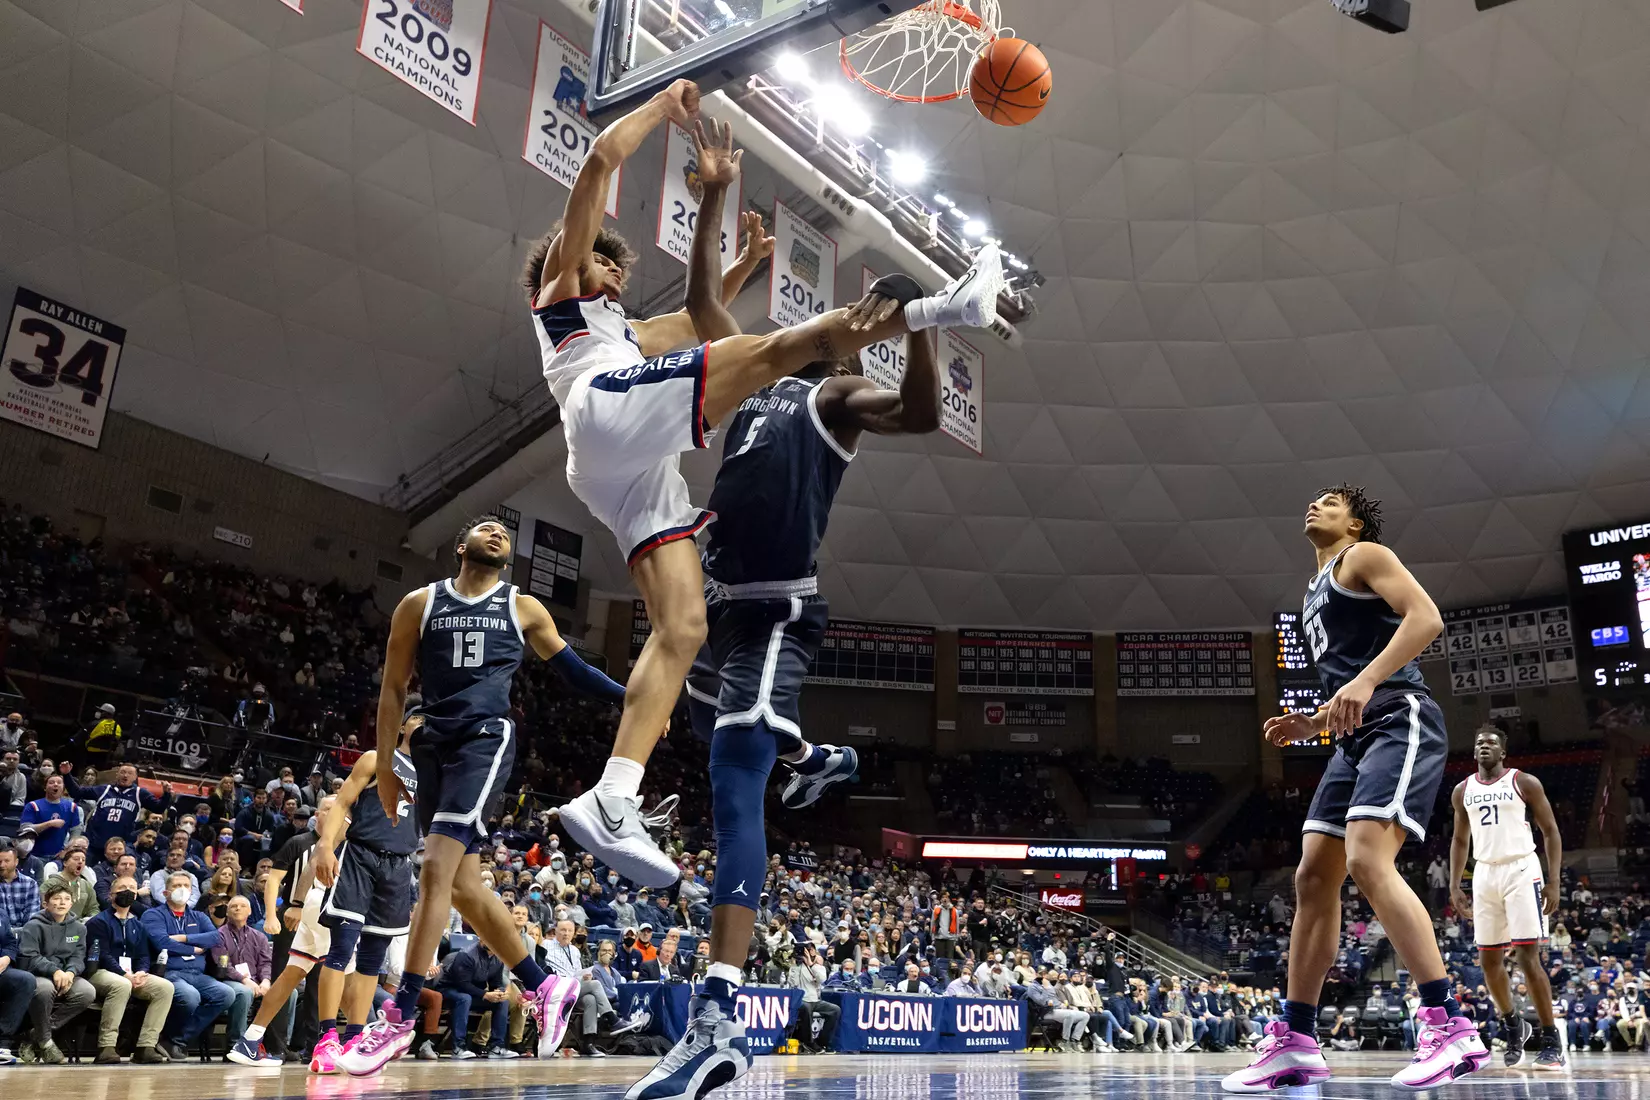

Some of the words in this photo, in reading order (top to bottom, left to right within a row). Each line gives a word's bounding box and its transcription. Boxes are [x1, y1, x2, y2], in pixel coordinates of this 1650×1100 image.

[375, 0, 472, 77] 2009
[549, 31, 580, 59] UConn
[383, 32, 459, 92] NATIONAL
[561, 53, 589, 79] Baske
[374, 46, 463, 111] CHAMPIONS
[540, 109, 590, 158] 201
[543, 140, 580, 172] NATIO
[779, 274, 825, 315] 2014
[40, 299, 64, 318] RAY
[66, 308, 104, 335] ALLEN
[8, 317, 110, 407] 34
[868, 359, 900, 386] NATIONA
[942, 387, 977, 423] 2016
[0, 400, 46, 421] NUMBER
[48, 415, 96, 438] RETIRED
[943, 408, 976, 435] NATIONAL
[735, 416, 768, 457] 5
[941, 418, 978, 449] CHAMPIONS
[231, 535, 251, 547] 210
[1589, 523, 1650, 547] UNIVER
[1579, 560, 1622, 575] WELLS
[1582, 570, 1622, 585] FARGO
[431, 615, 508, 632] GEORGETOWN
[867, 625, 895, 633] ATHLETIC
[1545, 623, 1569, 638] 42
[873, 633, 924, 643] CHAMPIONS
[1123, 634, 1154, 642] NCAA
[1159, 633, 1244, 641] CHAMPIONSHIP
[1481, 632, 1504, 646] 44
[1591, 627, 1624, 639] CBS
[452, 631, 485, 668] 13
[918, 645, 934, 655] 2011
[1451, 635, 1473, 650] 42
[1454, 672, 1477, 688] 24
[1488, 669, 1506, 684] 13
[1518, 665, 1540, 681] 22
[1594, 668, 1607, 686] 5
[804, 676, 850, 686] ONNECTICUT
[882, 682, 932, 690] BASKETBALL
[988, 710, 1002, 718] NIT
[140, 736, 162, 748] SEC
[166, 738, 200, 757] 109
[1465, 792, 1513, 806] UCONN
[107, 807, 122, 822] 23
[1478, 804, 1499, 826] 21
[1028, 847, 1057, 857] ONLY
[1057, 847, 1067, 857] A
[1049, 893, 1083, 907] Coca-Cola
[735, 994, 789, 1029] ONN
[857, 998, 933, 1032] UCONN
[956, 1003, 1020, 1033] UCONN
[867, 1036, 921, 1047] BASKETBALL
[966, 1037, 1010, 1047] BASKETBALL
